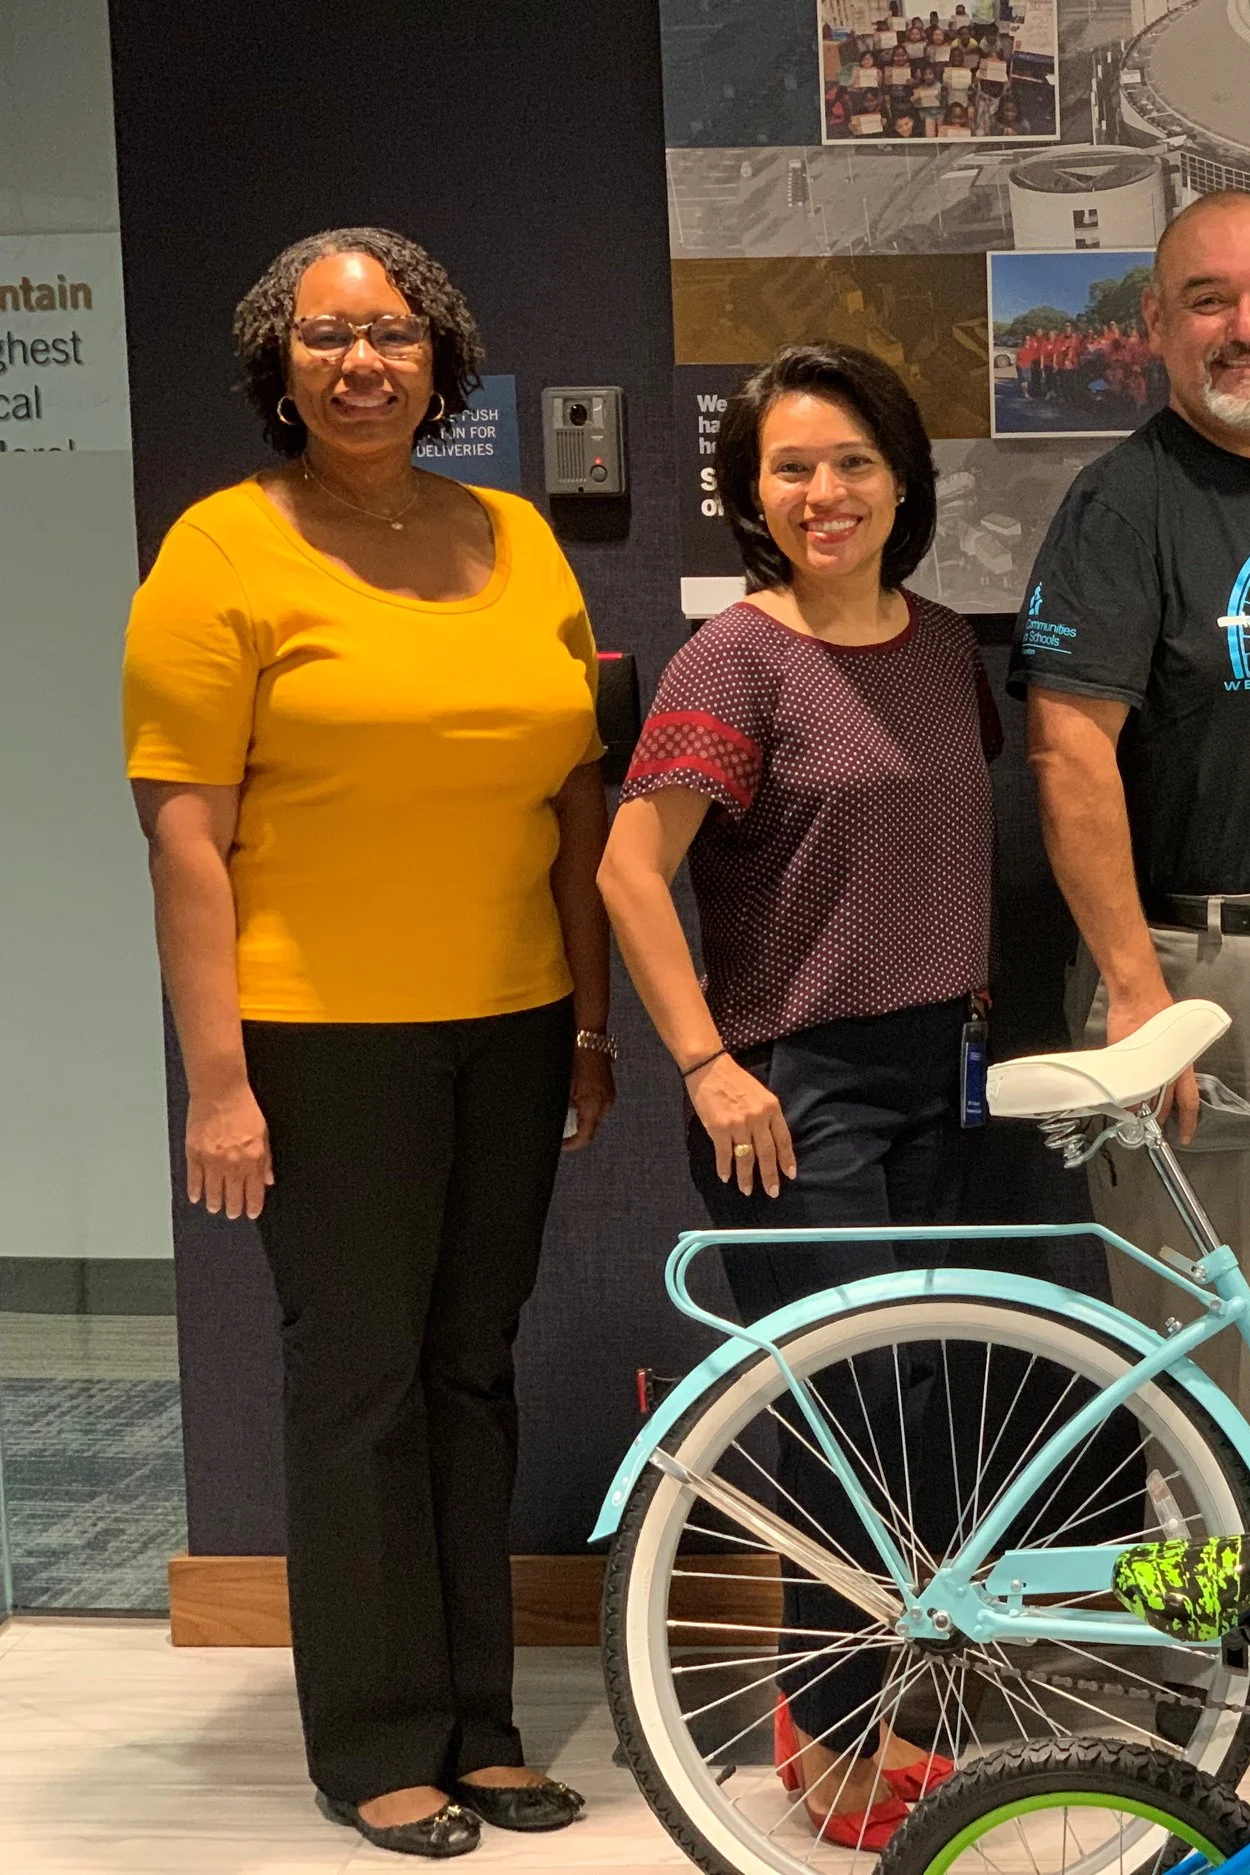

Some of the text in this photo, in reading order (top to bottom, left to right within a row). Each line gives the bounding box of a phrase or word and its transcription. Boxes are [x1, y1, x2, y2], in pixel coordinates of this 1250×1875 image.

[470, 426, 496, 438] FOR
[416, 443, 494, 457] DELIVERIES
[1029, 631, 1060, 646] Schools
